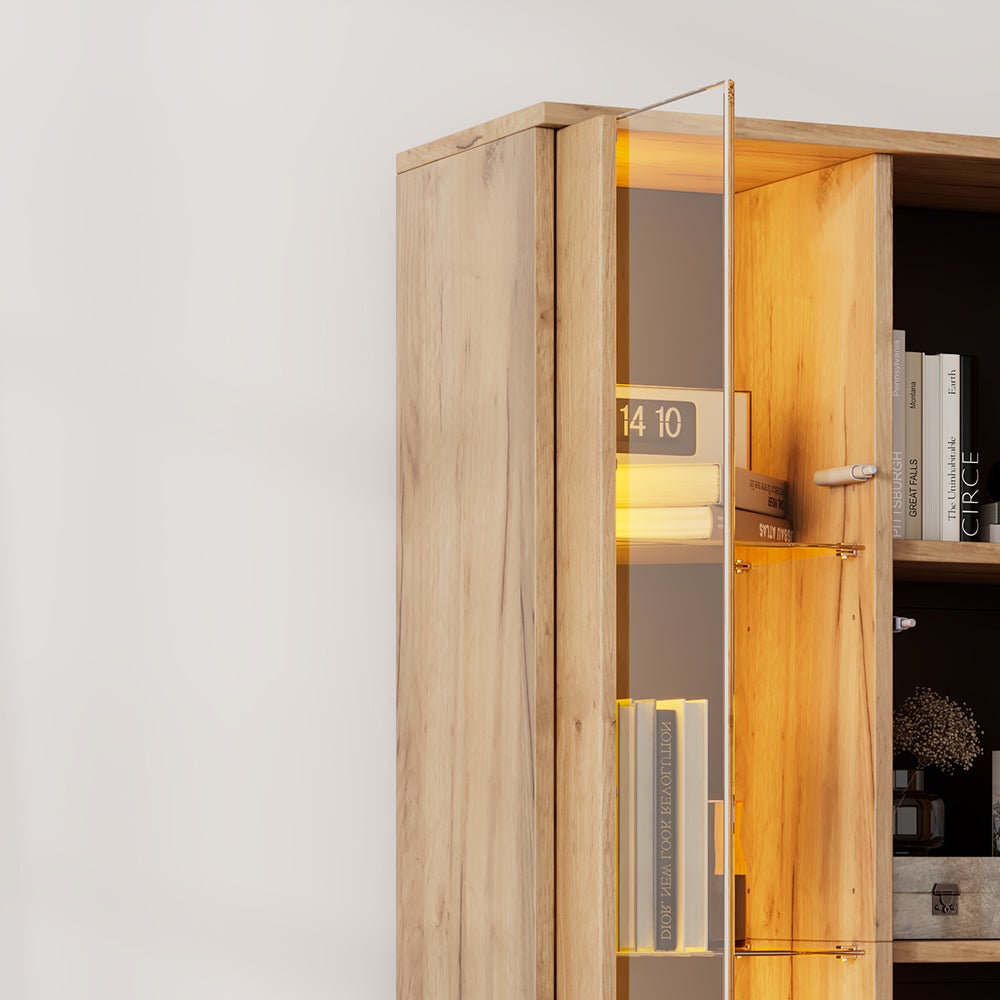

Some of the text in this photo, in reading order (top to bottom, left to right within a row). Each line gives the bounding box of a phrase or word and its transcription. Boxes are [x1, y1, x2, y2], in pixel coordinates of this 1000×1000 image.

[909, 381, 917, 409] Montana
[947, 369, 957, 395] Earth
[620, 404, 682, 438] 14 10
[908, 458, 918, 518] GREAT FALLS
[947, 436, 957, 521] The Uninhabitable
[961, 452, 980, 537] CIRCE
